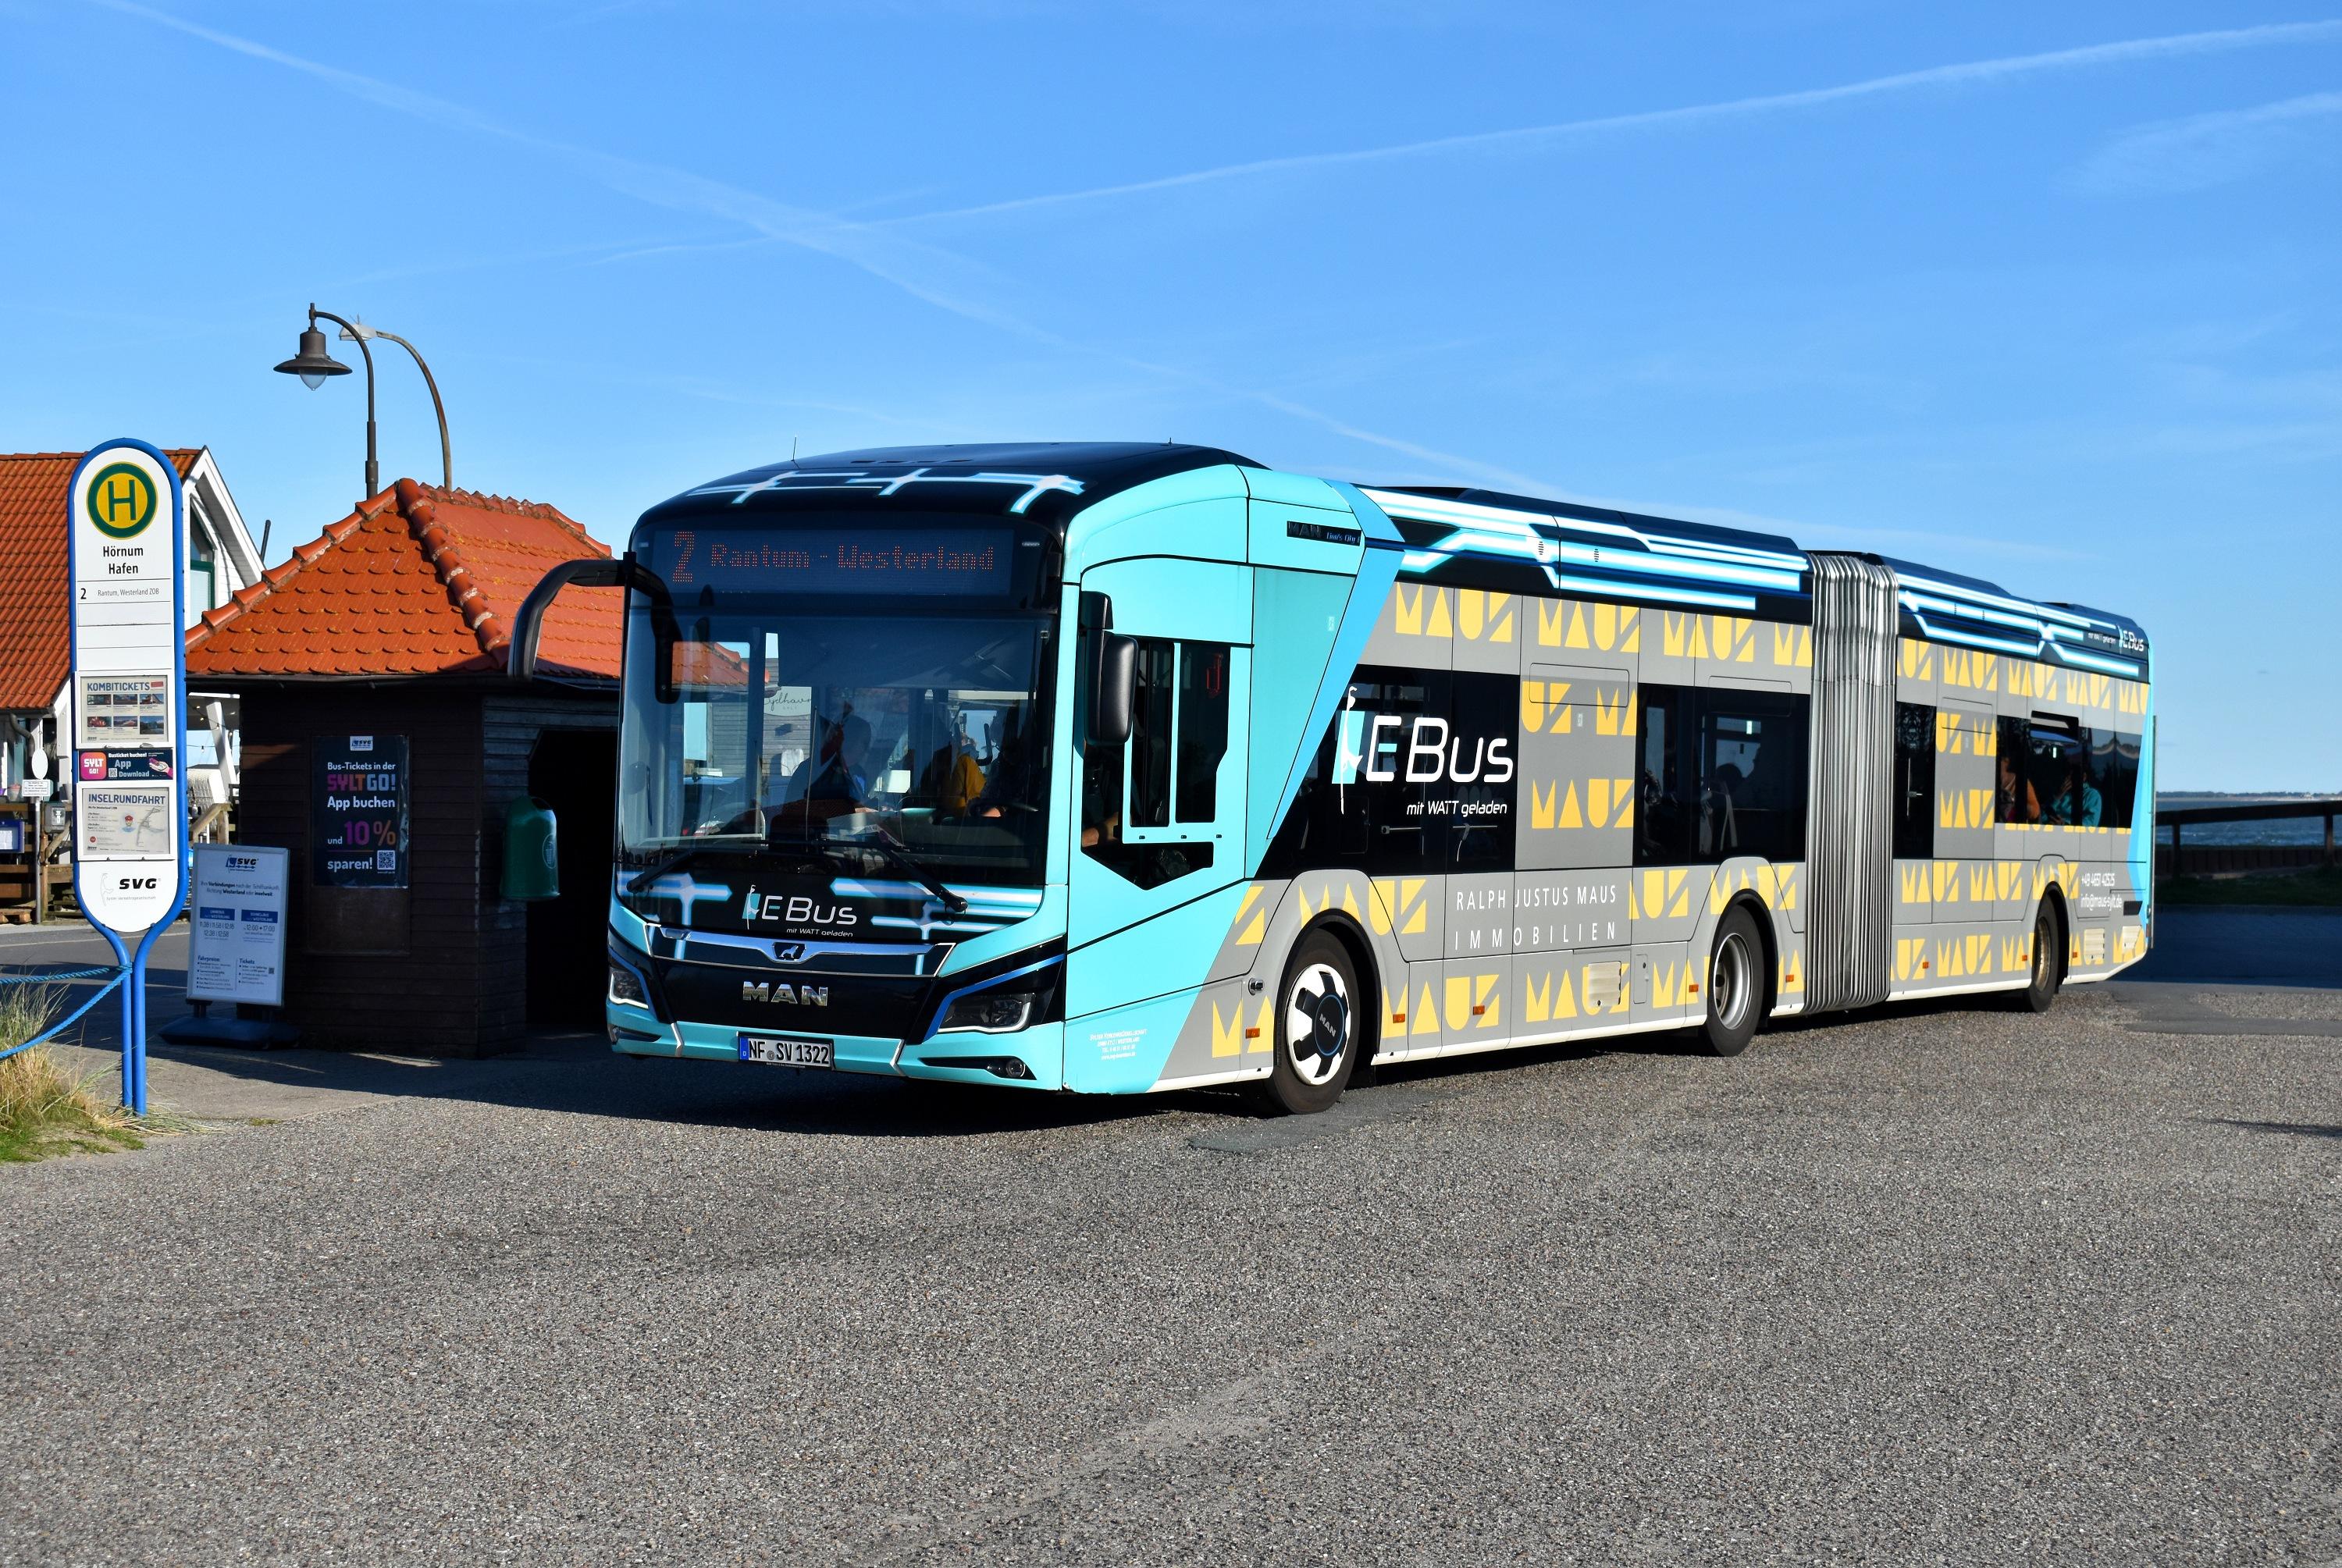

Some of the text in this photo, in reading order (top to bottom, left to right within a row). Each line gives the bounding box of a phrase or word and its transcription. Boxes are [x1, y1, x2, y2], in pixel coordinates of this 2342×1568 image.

[107, 479, 137, 522] H
[103, 546, 144, 557] Hörnum
[672, 531, 695, 583] 2
[710, 543, 810, 567] Rantum
[838, 545, 994, 571] Westerland
[109, 563, 139, 574] Hafen
[80, 588, 87, 600] 2
[119, 588, 148, 596] Westerland
[87, 681, 150, 692] KOMBITICKETS
[84, 758, 104, 768] SYLT
[115, 759, 132, 770] App
[327, 762, 396, 770] Bus-Tickets in der
[88, 794, 166, 805] INSELRUNDFAHRT
[327, 796, 396, 811] App buchen
[1407, 800, 1507, 818] mit WATT geladen
[327, 857, 373, 873] sparen!
[119, 878, 157, 890] SVG
[1457, 884, 1616, 911] RALPH JUSTUS MAUS
[1455, 921, 1615, 951] IMMOBILIEN
[743, 981, 829, 1007] MAN
[1319, 1013, 1337, 1037] MAN
[749, 1040, 766, 1058] NF
[776, 1042, 792, 1061] SV
[796, 1044, 830, 1065] 1322
